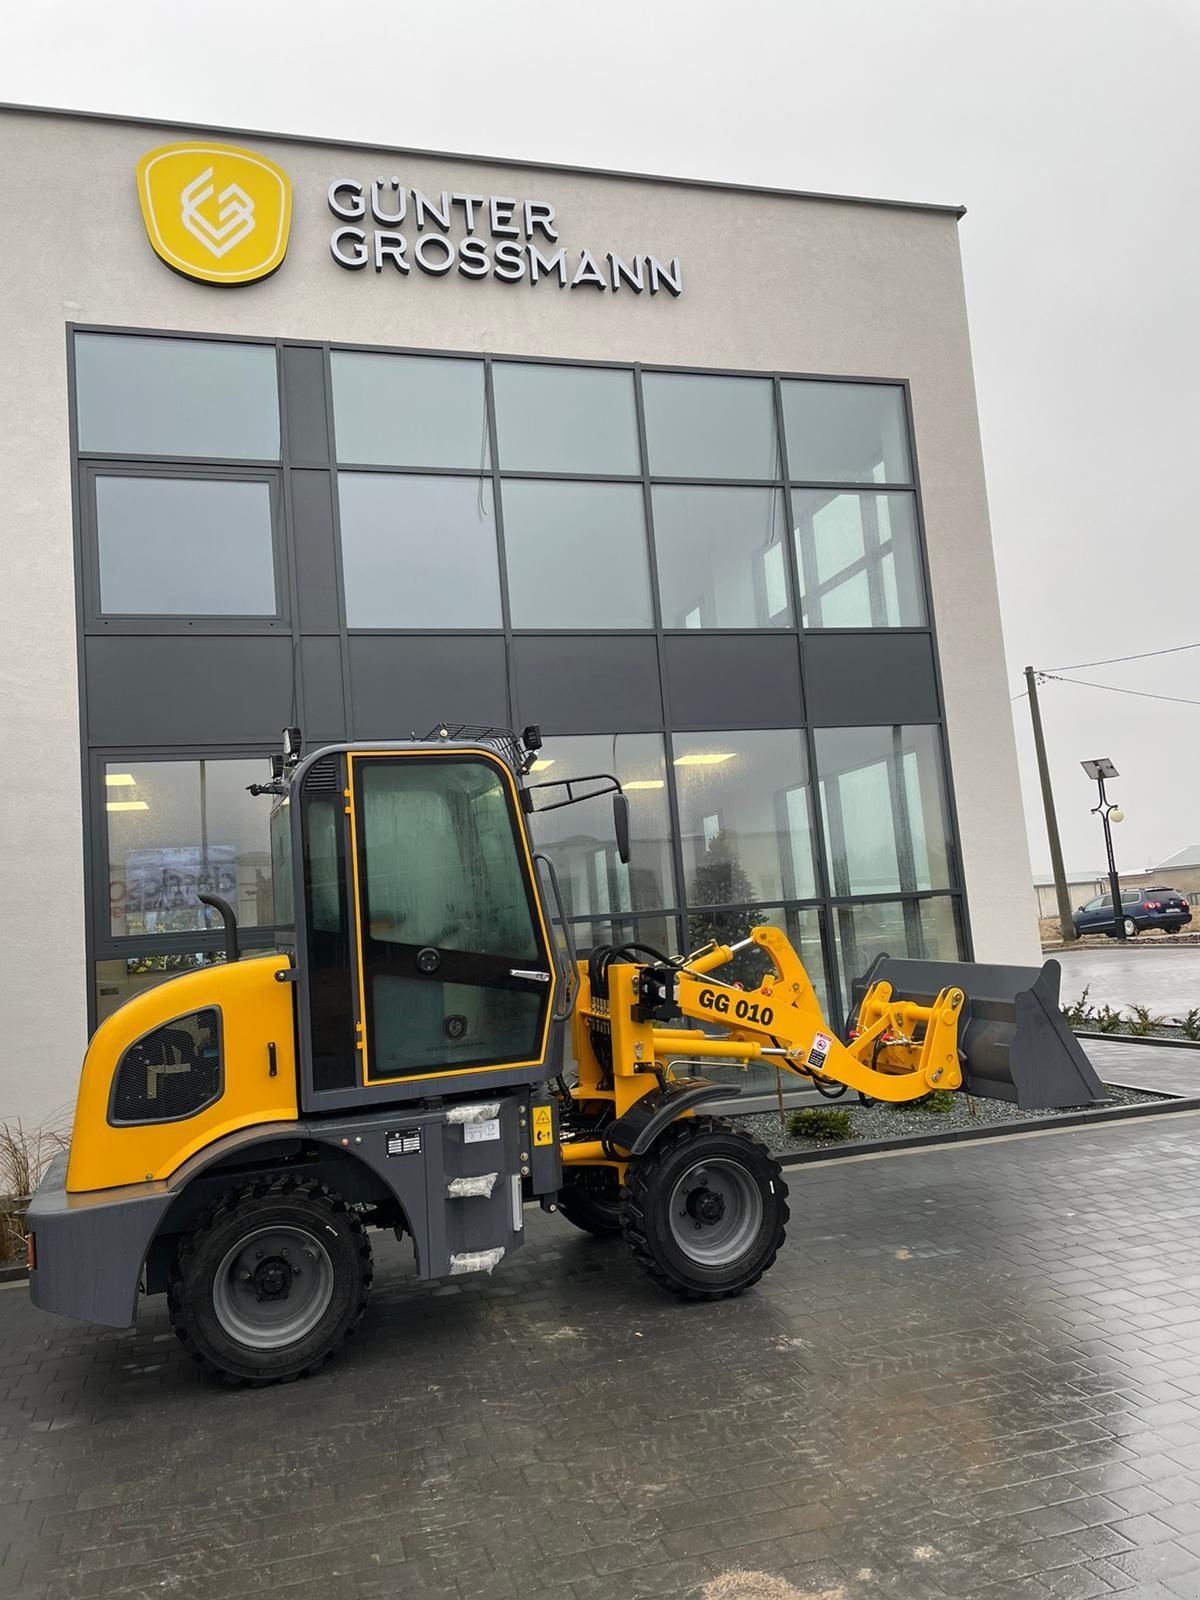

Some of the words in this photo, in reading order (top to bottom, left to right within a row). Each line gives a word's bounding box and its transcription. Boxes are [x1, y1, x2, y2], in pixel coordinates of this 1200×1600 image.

[327, 176, 558, 243] GÜNTER
[330, 226, 682, 297] GROSSMANN
[698, 989, 730, 1014] GG
[735, 1000, 774, 1026] 010
